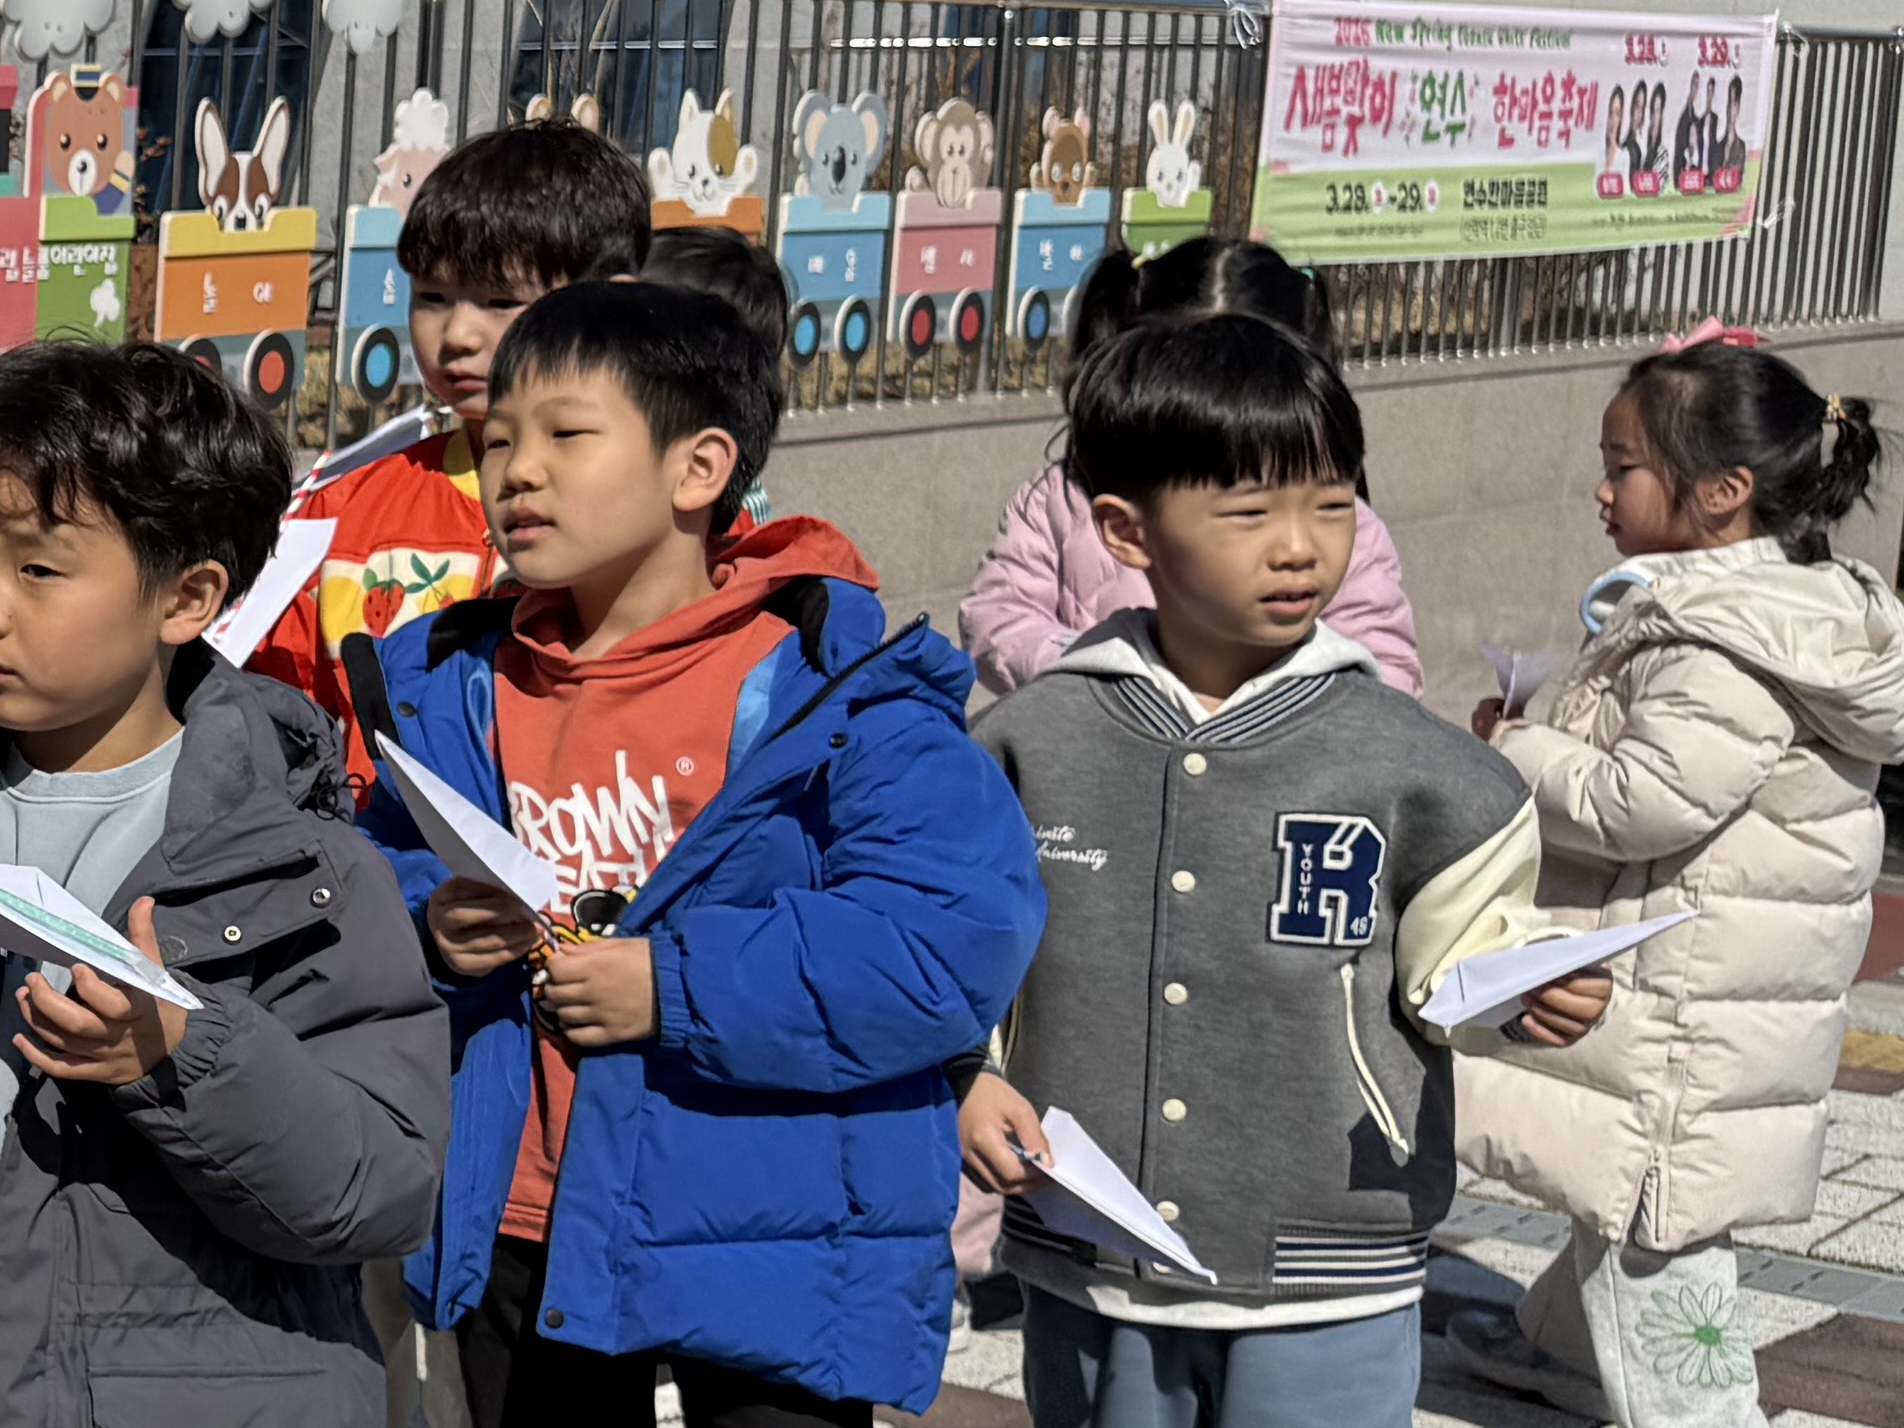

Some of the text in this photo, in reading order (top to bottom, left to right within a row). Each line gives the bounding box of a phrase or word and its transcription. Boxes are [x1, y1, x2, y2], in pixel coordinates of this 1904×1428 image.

[1283, 55, 1599, 158] 새봄맞이 연수 한마음축제
[1297, 843, 1314, 916] YOUTH
